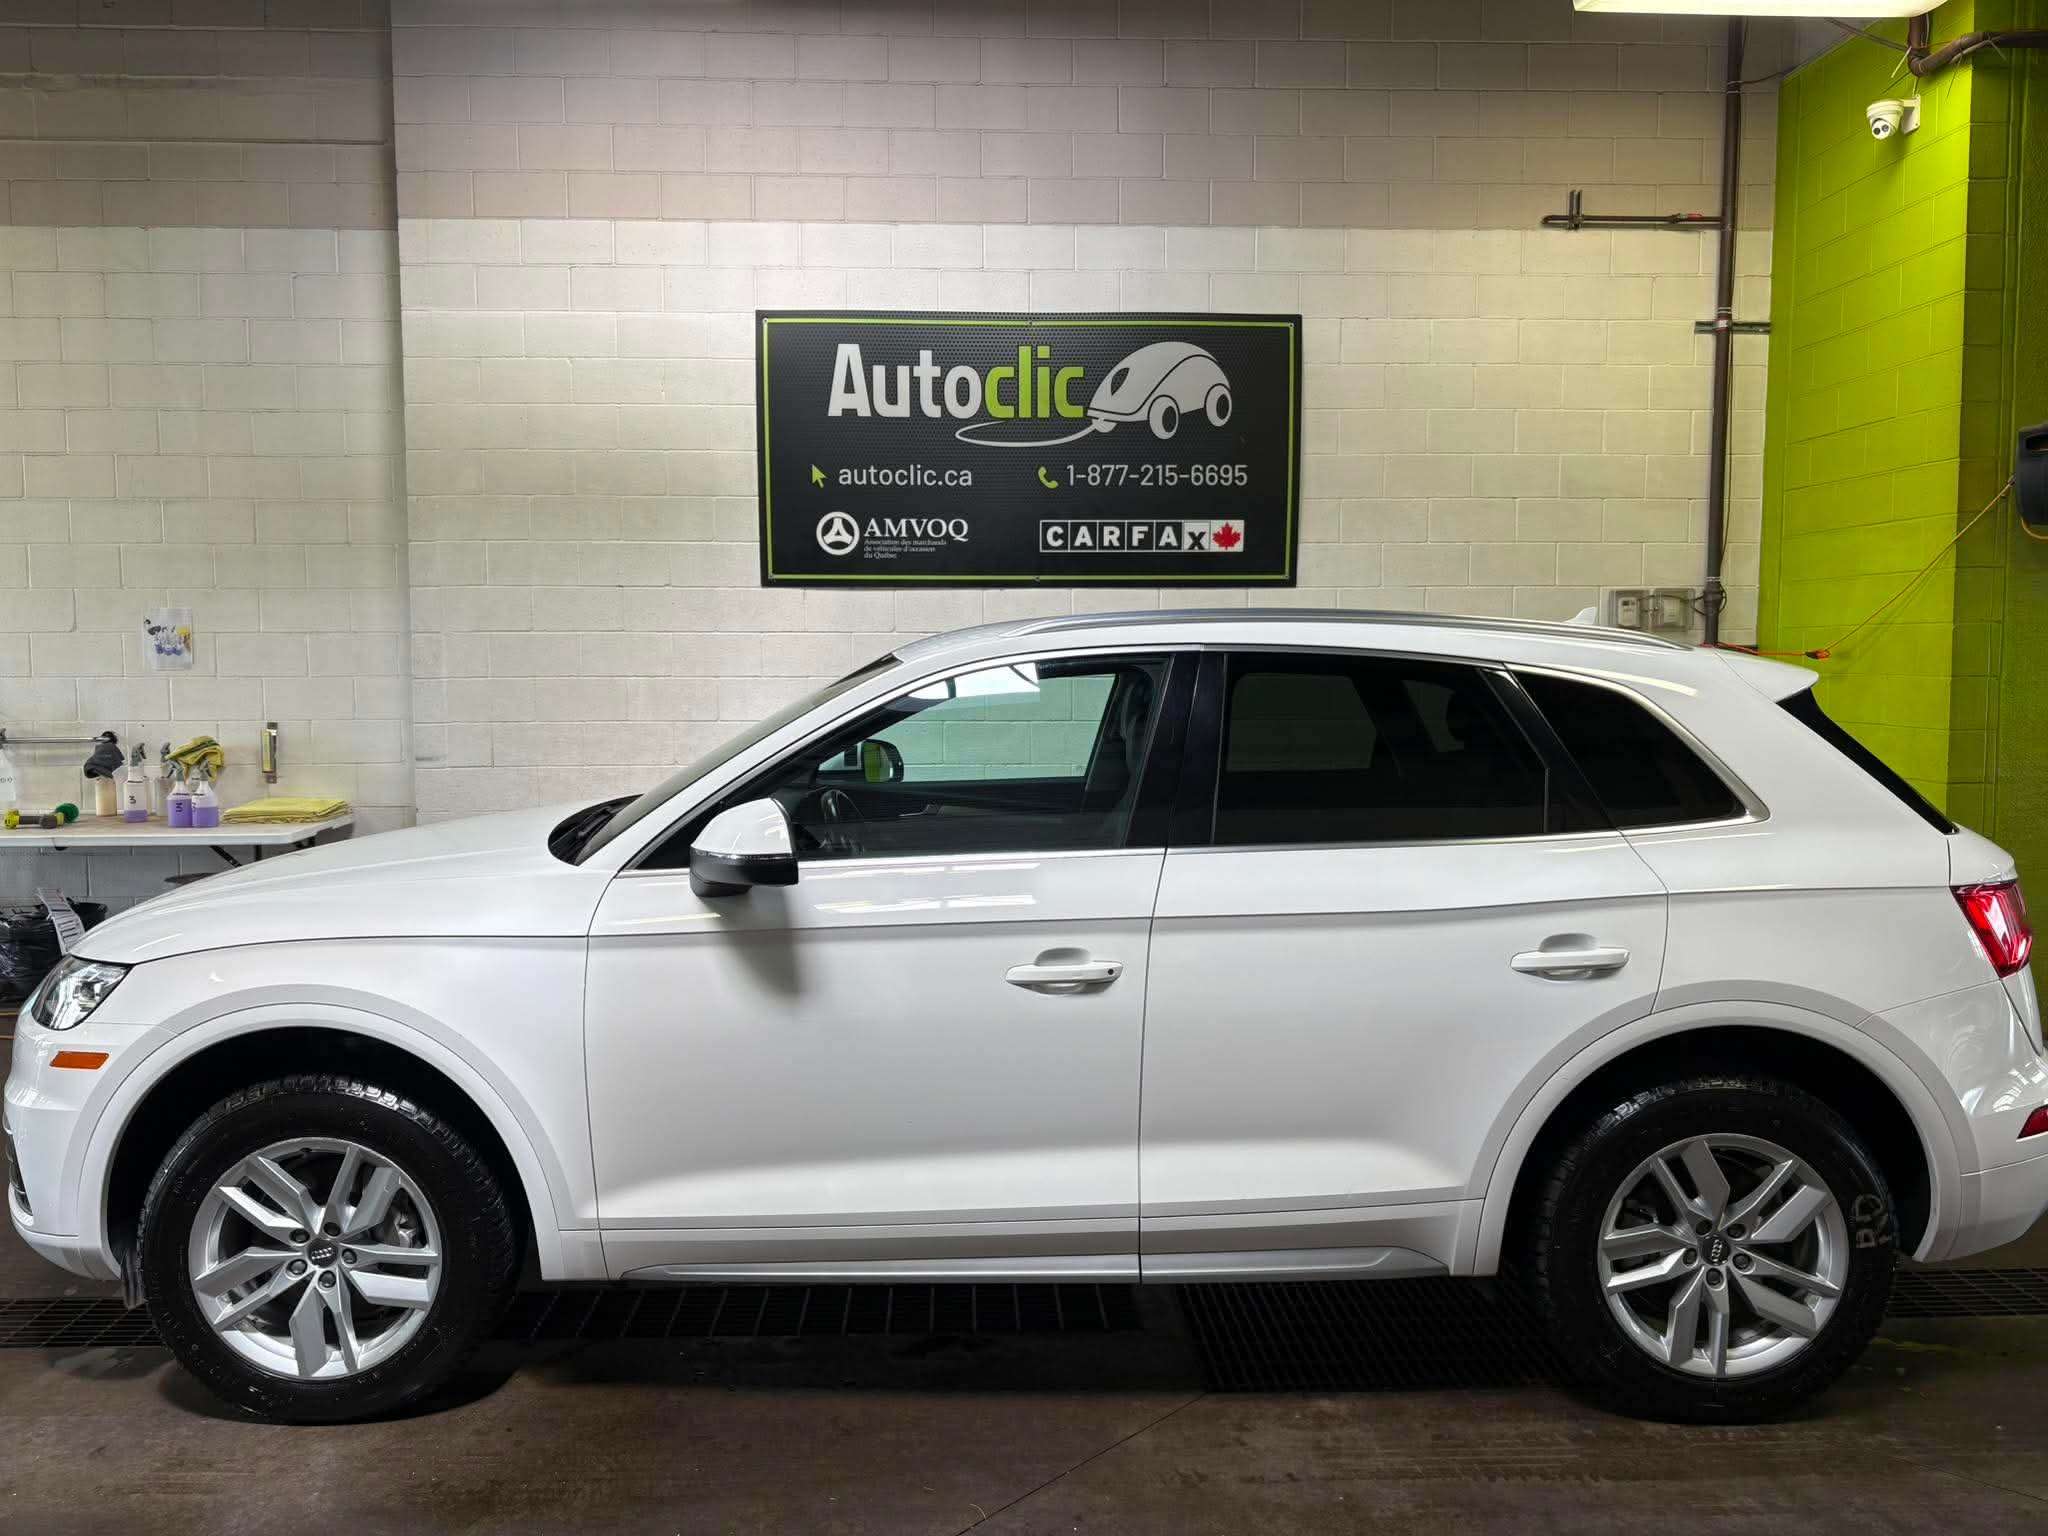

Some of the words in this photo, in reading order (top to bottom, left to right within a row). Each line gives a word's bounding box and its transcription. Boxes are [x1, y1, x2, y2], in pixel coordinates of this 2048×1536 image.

[828, 343, 1085, 419] Autoclic
[838, 464, 973, 486] autoclic.ca
[1066, 464, 1249, 486] 1-877-215-6695
[863, 517, 969, 542] AMVOQ
[1046, 525, 1207, 551] CARFAX
